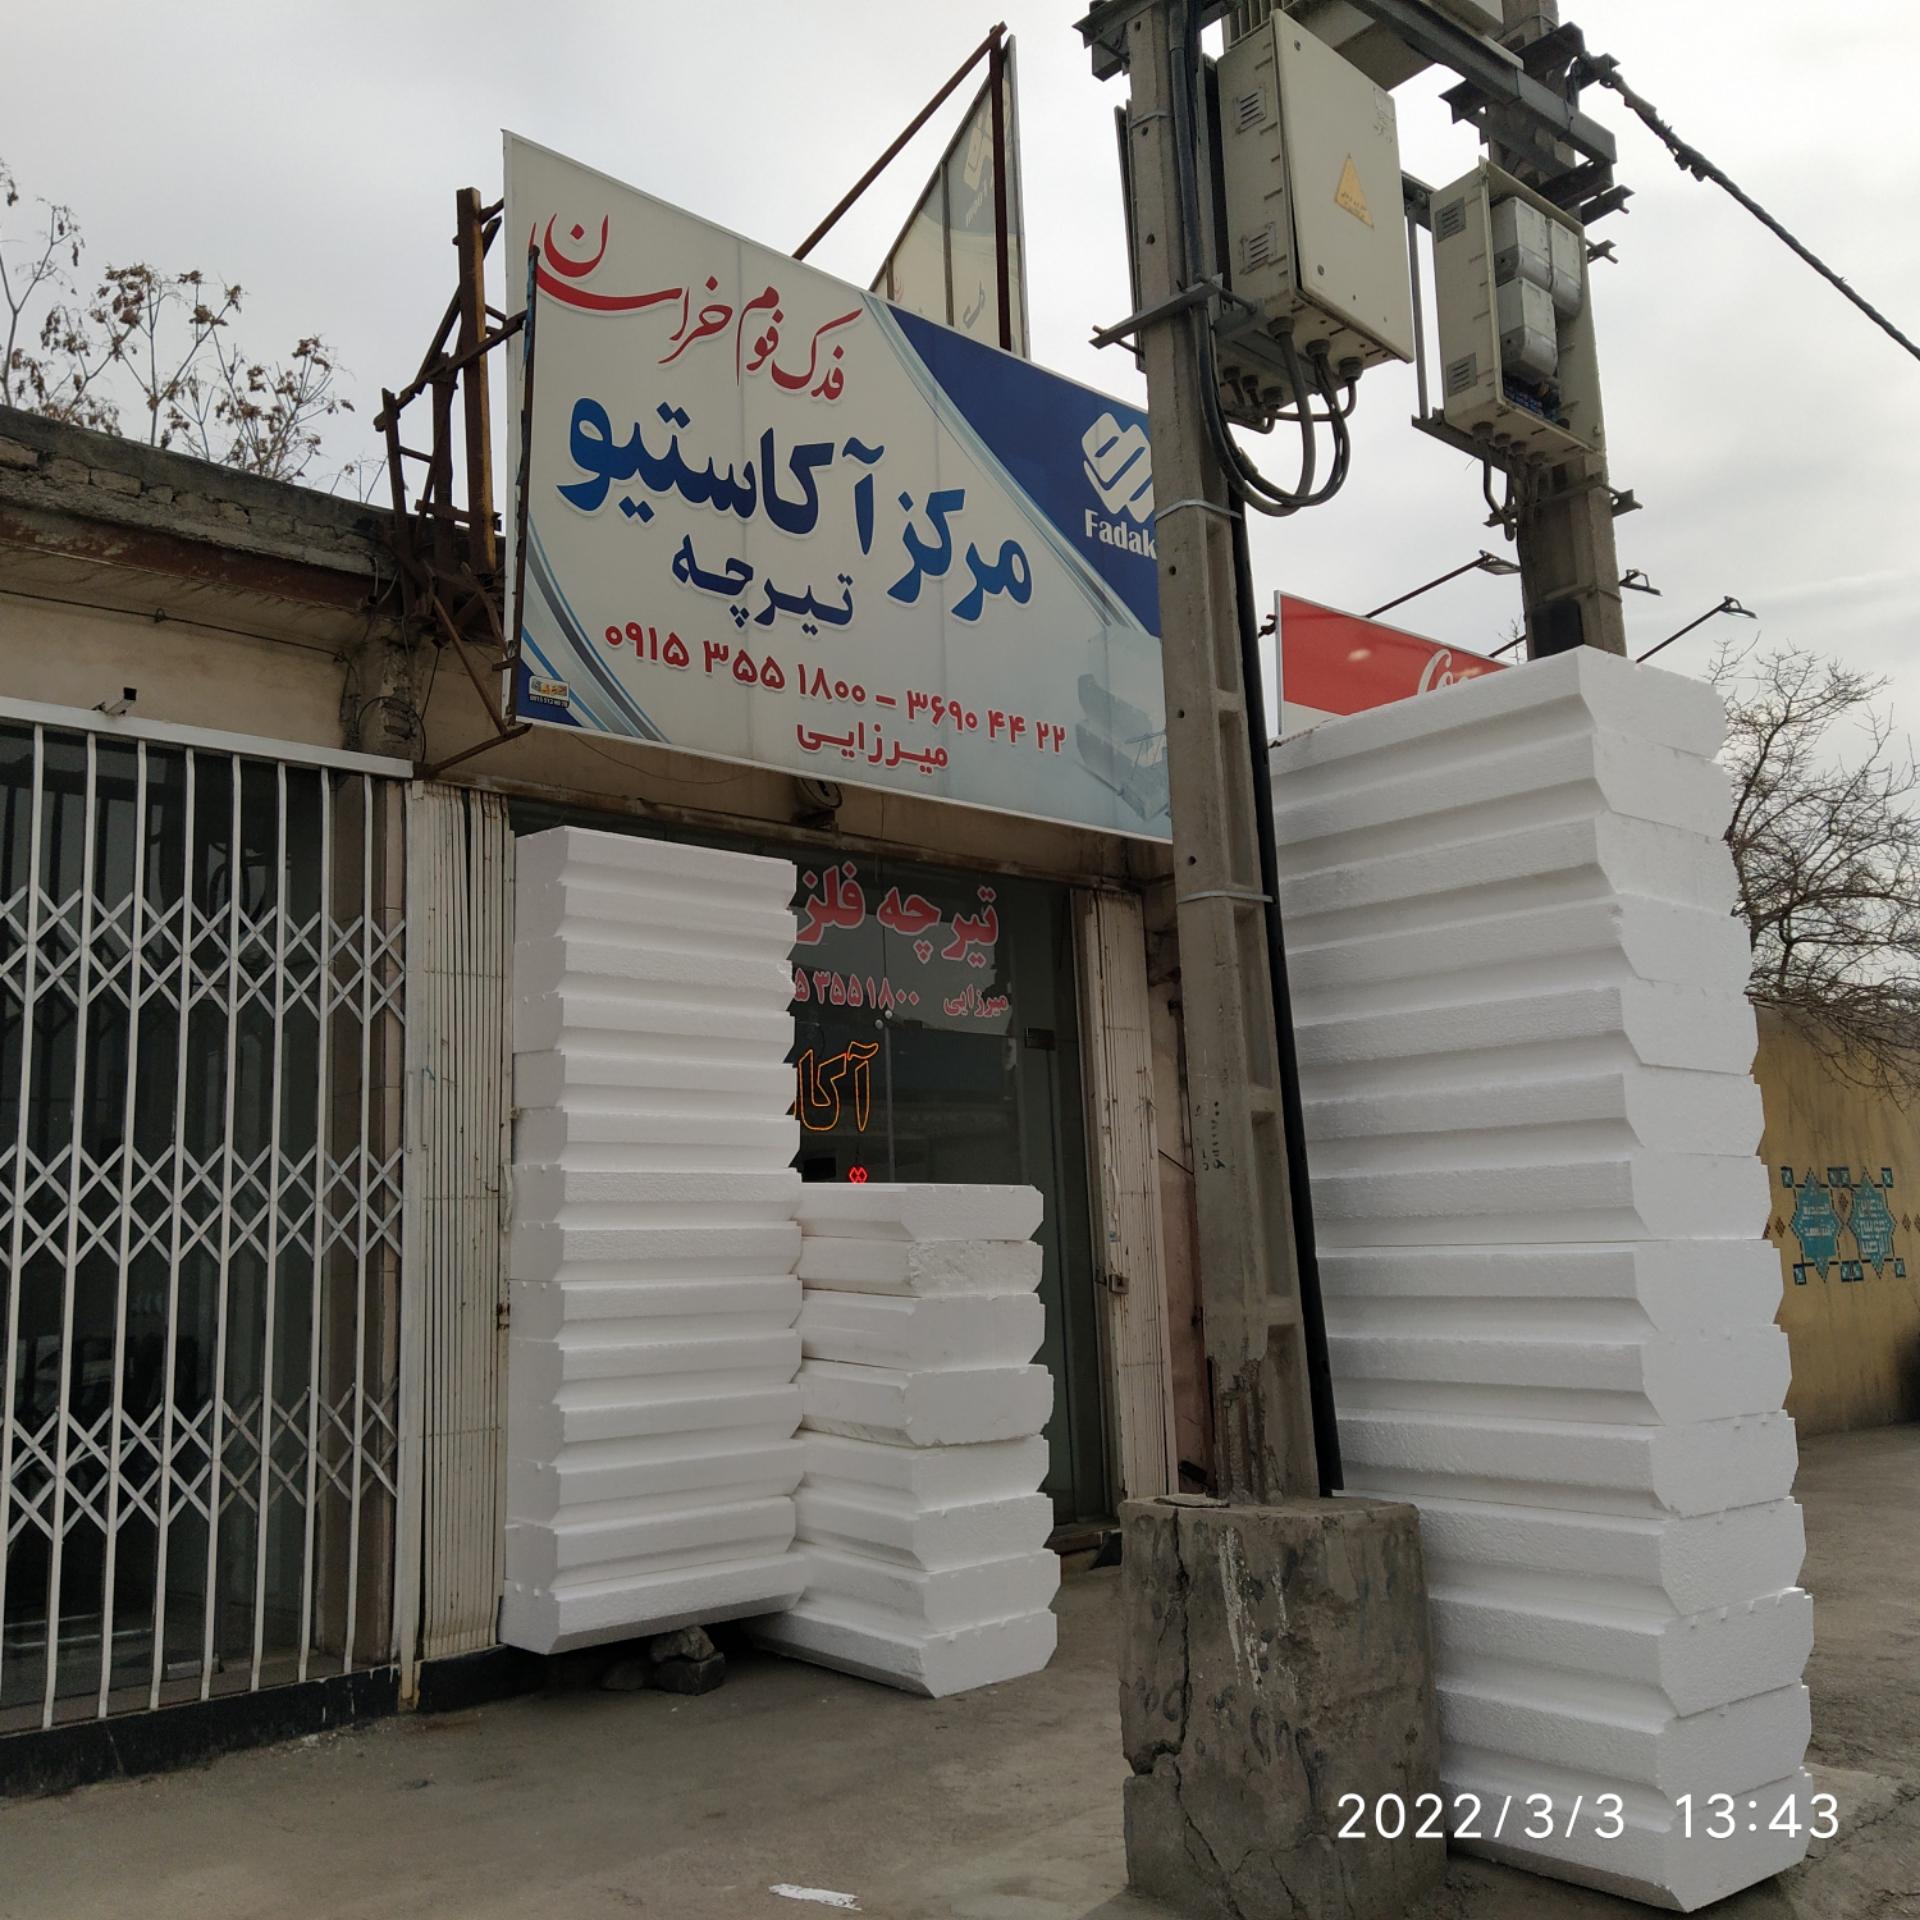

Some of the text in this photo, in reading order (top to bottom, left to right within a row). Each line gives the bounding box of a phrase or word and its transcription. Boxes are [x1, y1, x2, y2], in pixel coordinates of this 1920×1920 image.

[527, 213, 864, 401] فدک فوم خراسان
[556, 396, 1034, 622] مرکز آکاستیو
[1084, 508, 1158, 560] Fadak
[672, 534, 855, 637] تیرچه
[703, 640, 786, 690] ۳۵۵
[798, 663, 866, 701] ۱۸۰۰
[987, 709, 1026, 743] ۴۴
[1035, 721, 1067, 753] ۲۲
[796, 720, 949, 774] میرزایی
[877, 885, 999, 968] تیرچه
[943, 983, 1009, 1017] میرزایی
[795, 1041, 880, 1132] آکا
